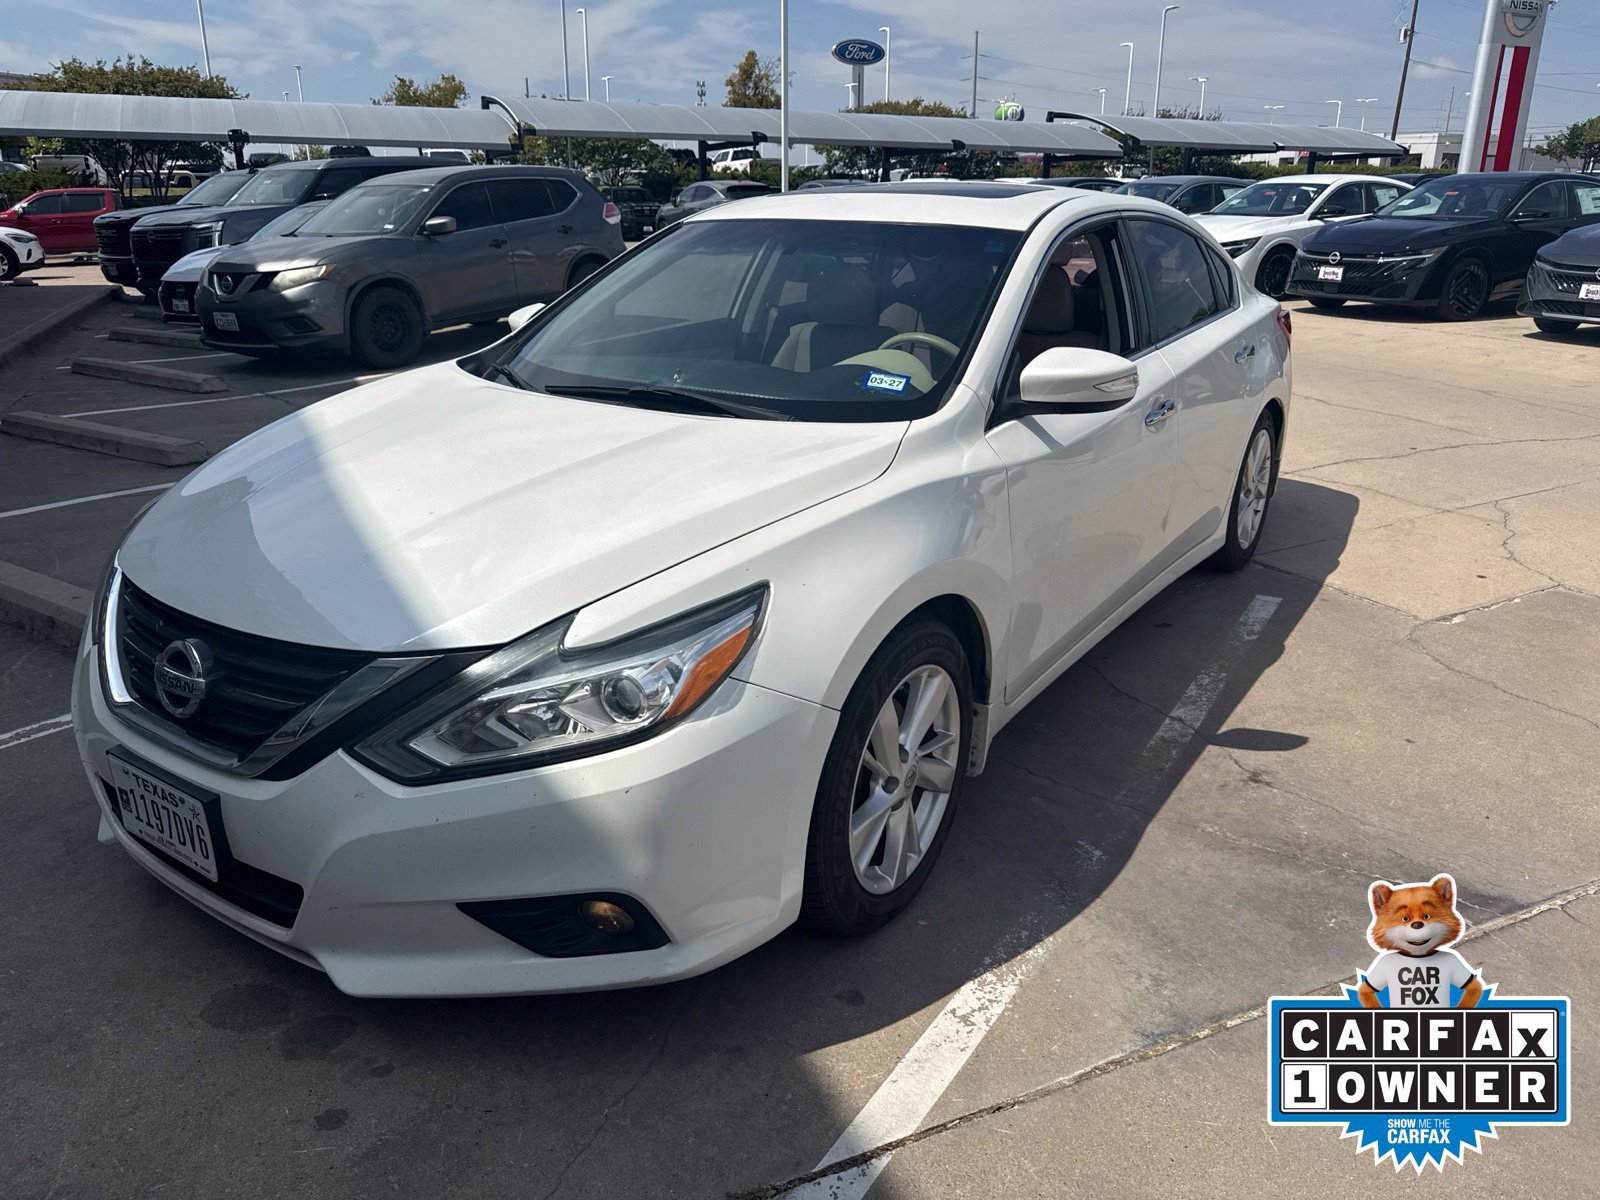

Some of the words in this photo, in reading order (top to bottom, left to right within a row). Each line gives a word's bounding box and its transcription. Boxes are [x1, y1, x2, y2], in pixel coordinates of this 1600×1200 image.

[845, 43, 875, 60] Ford
[157, 670, 194, 694] ISSAN
[131, 773, 179, 808] TEXAS
[129, 788, 210, 860] 1197DV6
